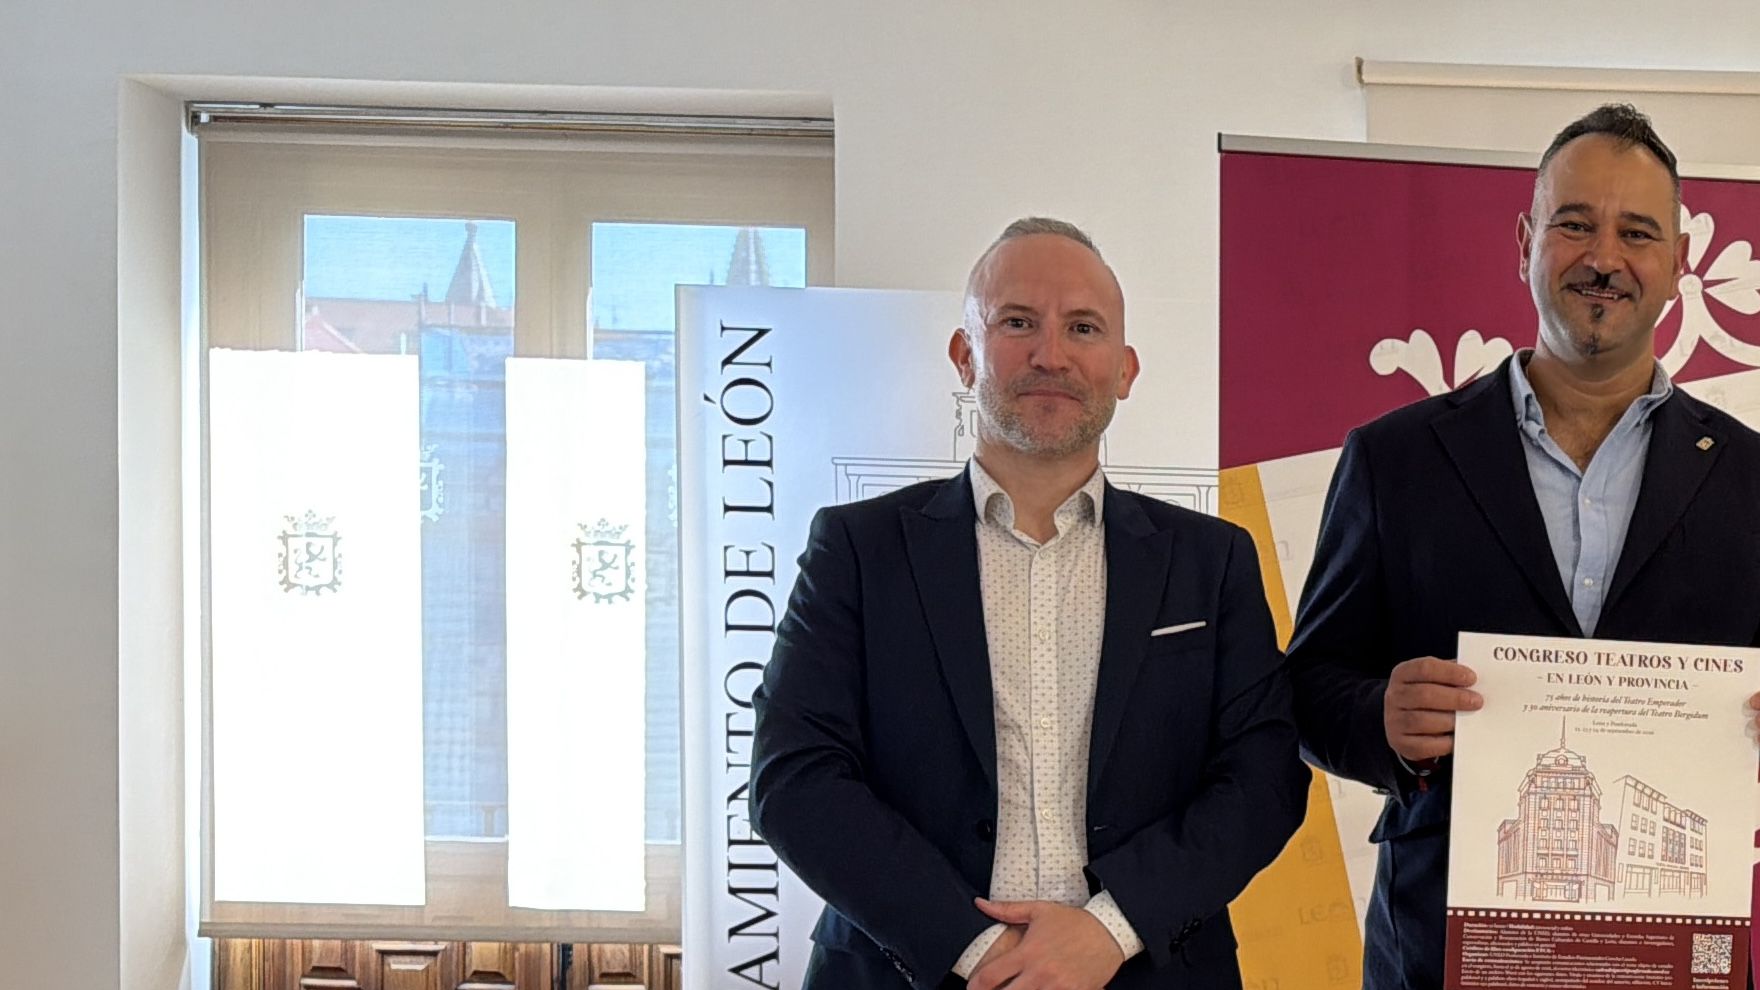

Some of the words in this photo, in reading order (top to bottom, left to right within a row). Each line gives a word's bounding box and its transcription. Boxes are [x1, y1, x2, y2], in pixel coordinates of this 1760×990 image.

[703, 319, 775, 519] LEÓN
[723, 544, 776, 638] DE
[1493, 646, 1588, 666] CONGRESO
[1594, 652, 1672, 670] TEATROS
[1677, 656, 1689, 671] Y
[1693, 658, 1744, 674] CINES
[1547, 672, 1564, 685] EN
[1568, 671, 1601, 686] LEÓN
[1606, 675, 1616, 687] Y
[1618, 676, 1689, 691] PROVINCIA
[1610, 694, 1622, 704] del
[1623, 695, 1645, 706] Teatro
[1647, 697, 1687, 708] Emperador
[1638, 707, 1649, 717] del
[1650, 707, 1673, 718] Teatro
